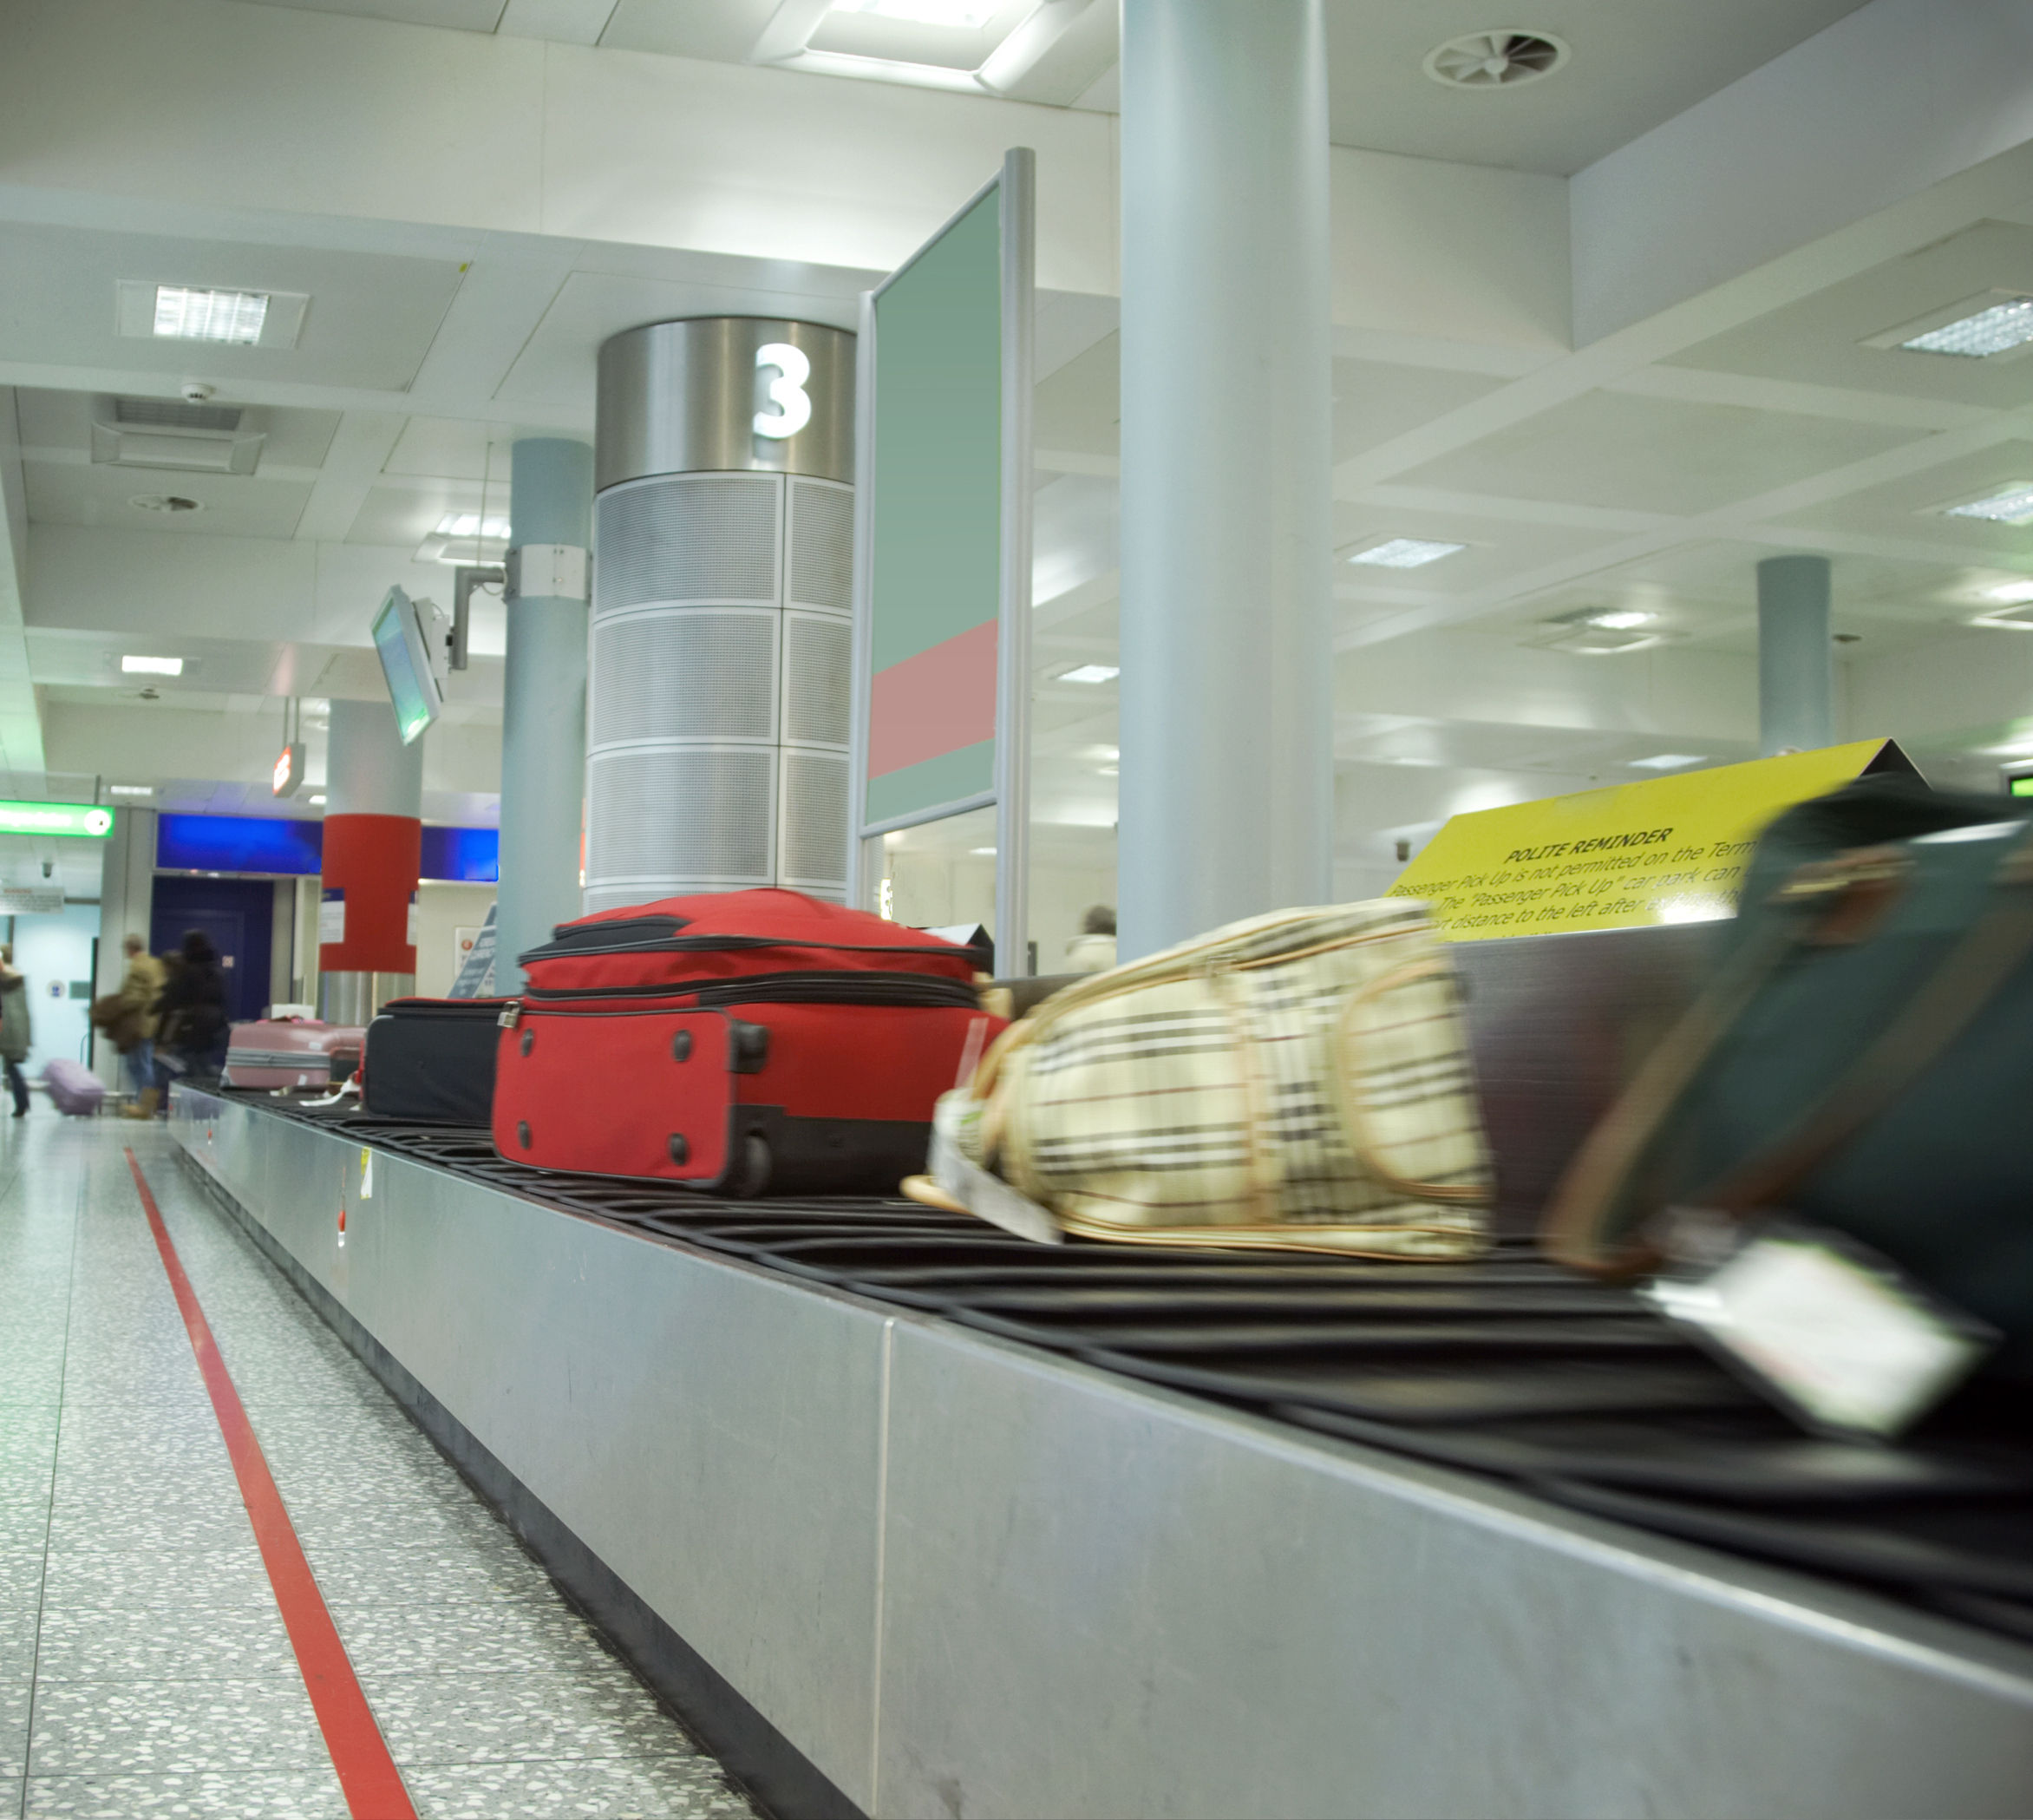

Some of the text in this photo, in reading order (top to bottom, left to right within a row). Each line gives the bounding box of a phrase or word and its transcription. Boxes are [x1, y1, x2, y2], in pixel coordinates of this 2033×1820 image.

[753, 343, 812, 440] 3
[1503, 828, 1674, 865] POLITE REMINDER
[1390, 841, 1757, 897] Passenger Pick Up is not permitted on the Term
[1550, 881, 1586, 899] Pick
[1589, 876, 1625, 897] Up"
[1624, 876, 1657, 891] car
[1651, 868, 1702, 891] park
[1703, 867, 1741, 882] can
[1451, 912, 1513, 930] distance
[1515, 909, 1534, 924] to
[1535, 905, 1566, 922] the
[1565, 900, 1599, 919] left
[1598, 898, 1646, 916] after
